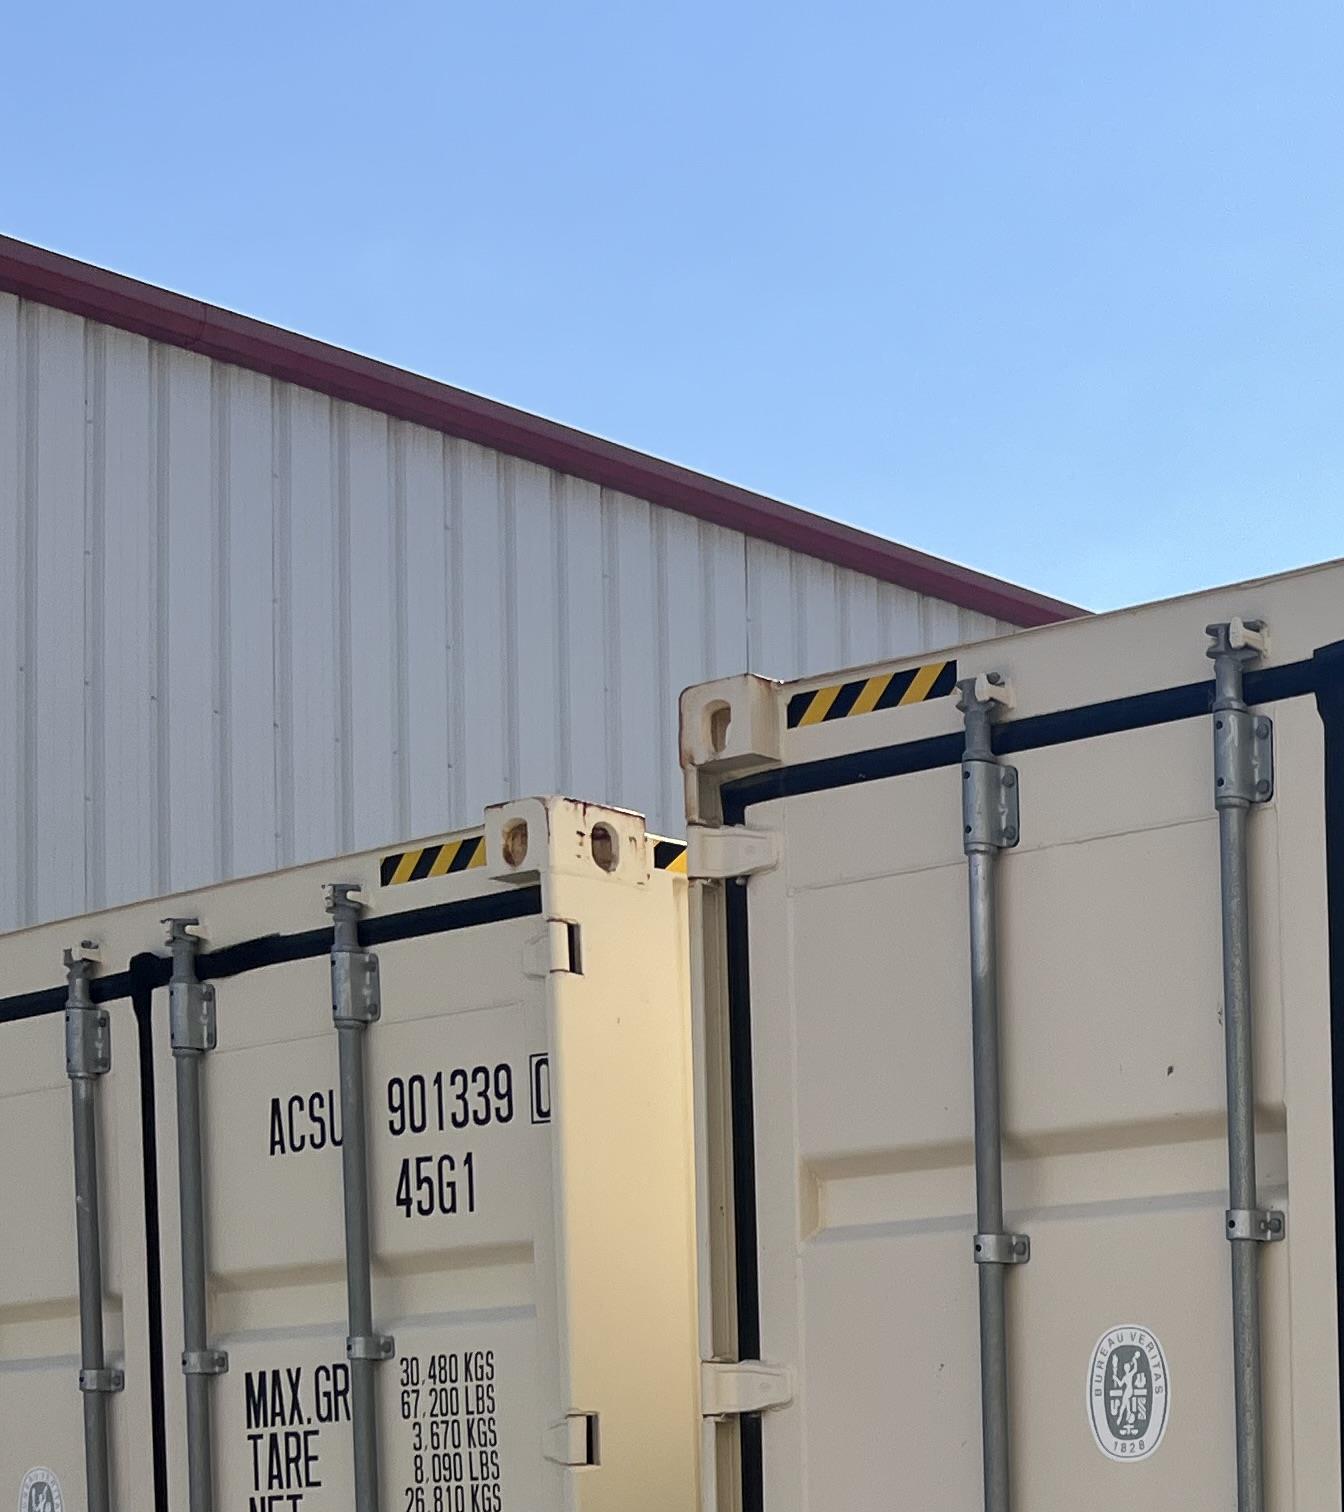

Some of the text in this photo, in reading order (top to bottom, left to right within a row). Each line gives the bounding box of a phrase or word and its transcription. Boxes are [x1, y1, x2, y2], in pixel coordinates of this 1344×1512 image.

[270, 1089, 343, 1156] ACSU
[388, 1063, 513, 1136] 901339
[396, 1152, 474, 1218] 45G1
[400, 1350, 495, 1387] 30,480 KGS
[1095, 1331, 1164, 1397] BUREAU VERITAS
[401, 1384, 495, 1419] 67,200 LBS
[412, 1417, 497, 1451] 3,670 KGS
[1113, 1440, 1145, 1454] 1828
[247, 1430, 321, 1491] TARE
[414, 1450, 500, 1484] 8,090 LBS
